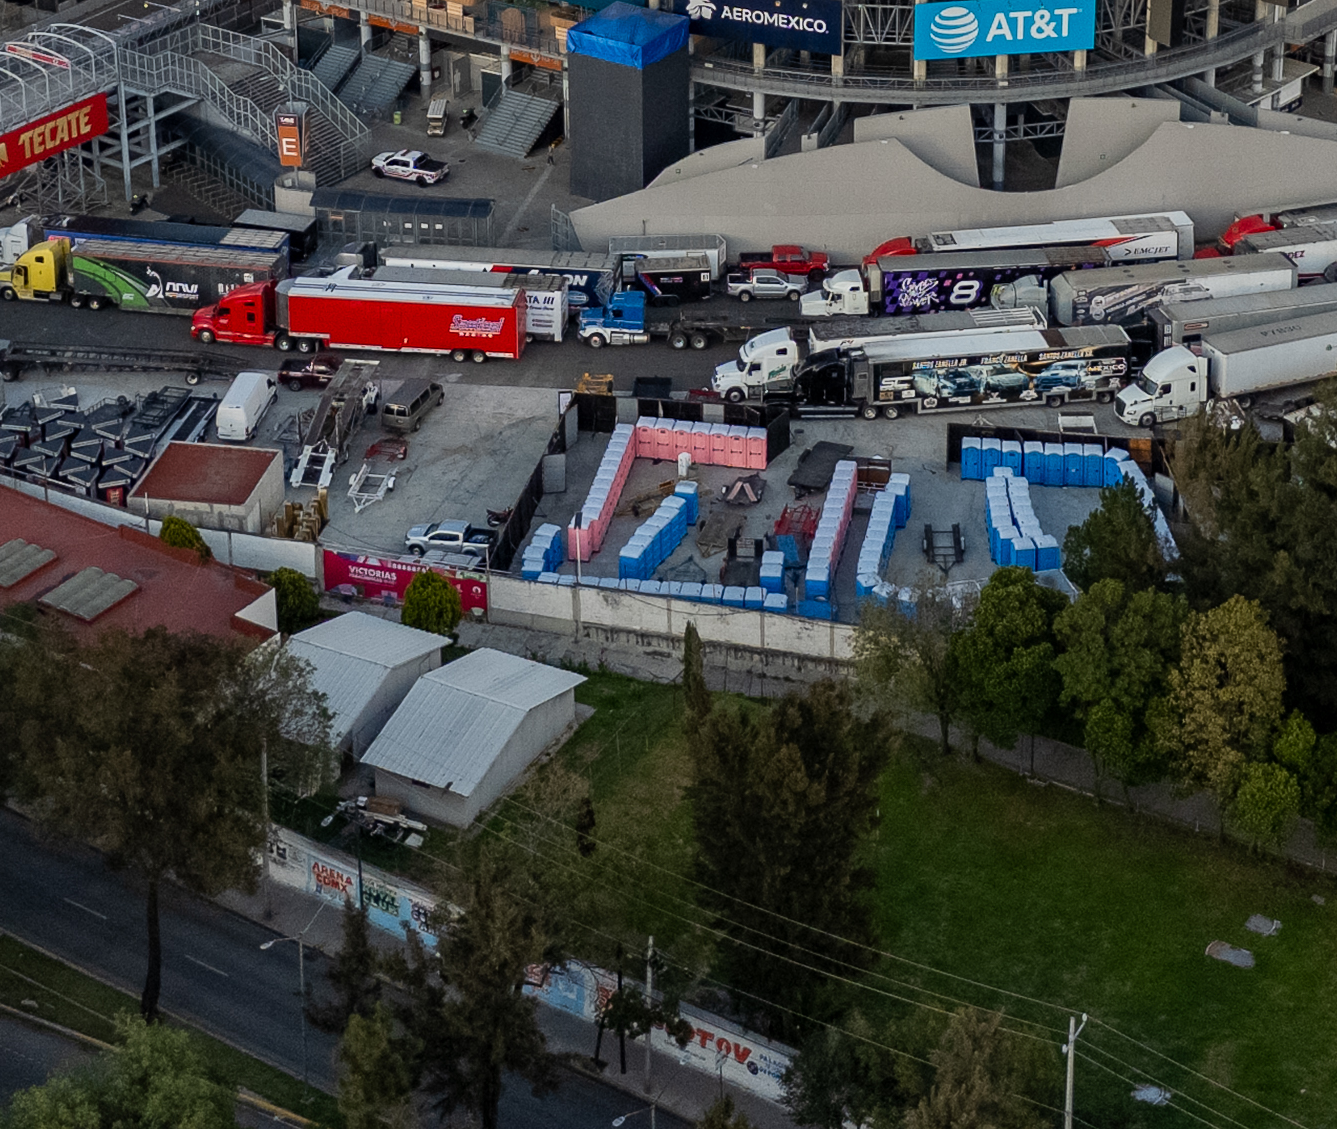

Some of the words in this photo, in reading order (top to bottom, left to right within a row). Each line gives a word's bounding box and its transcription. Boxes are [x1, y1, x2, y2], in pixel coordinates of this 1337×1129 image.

[720, 6, 827, 35] AEROMEXICO
[986, 7, 1077, 43] AT&T
[18, 103, 94, 159] TECATE
[282, 138, 298, 157] E
[950, 280, 981, 304] 8
[348, 565, 397, 581] VICTORIAS
[312, 861, 353, 886] ARENA
[315, 873, 349, 893] CDMX
